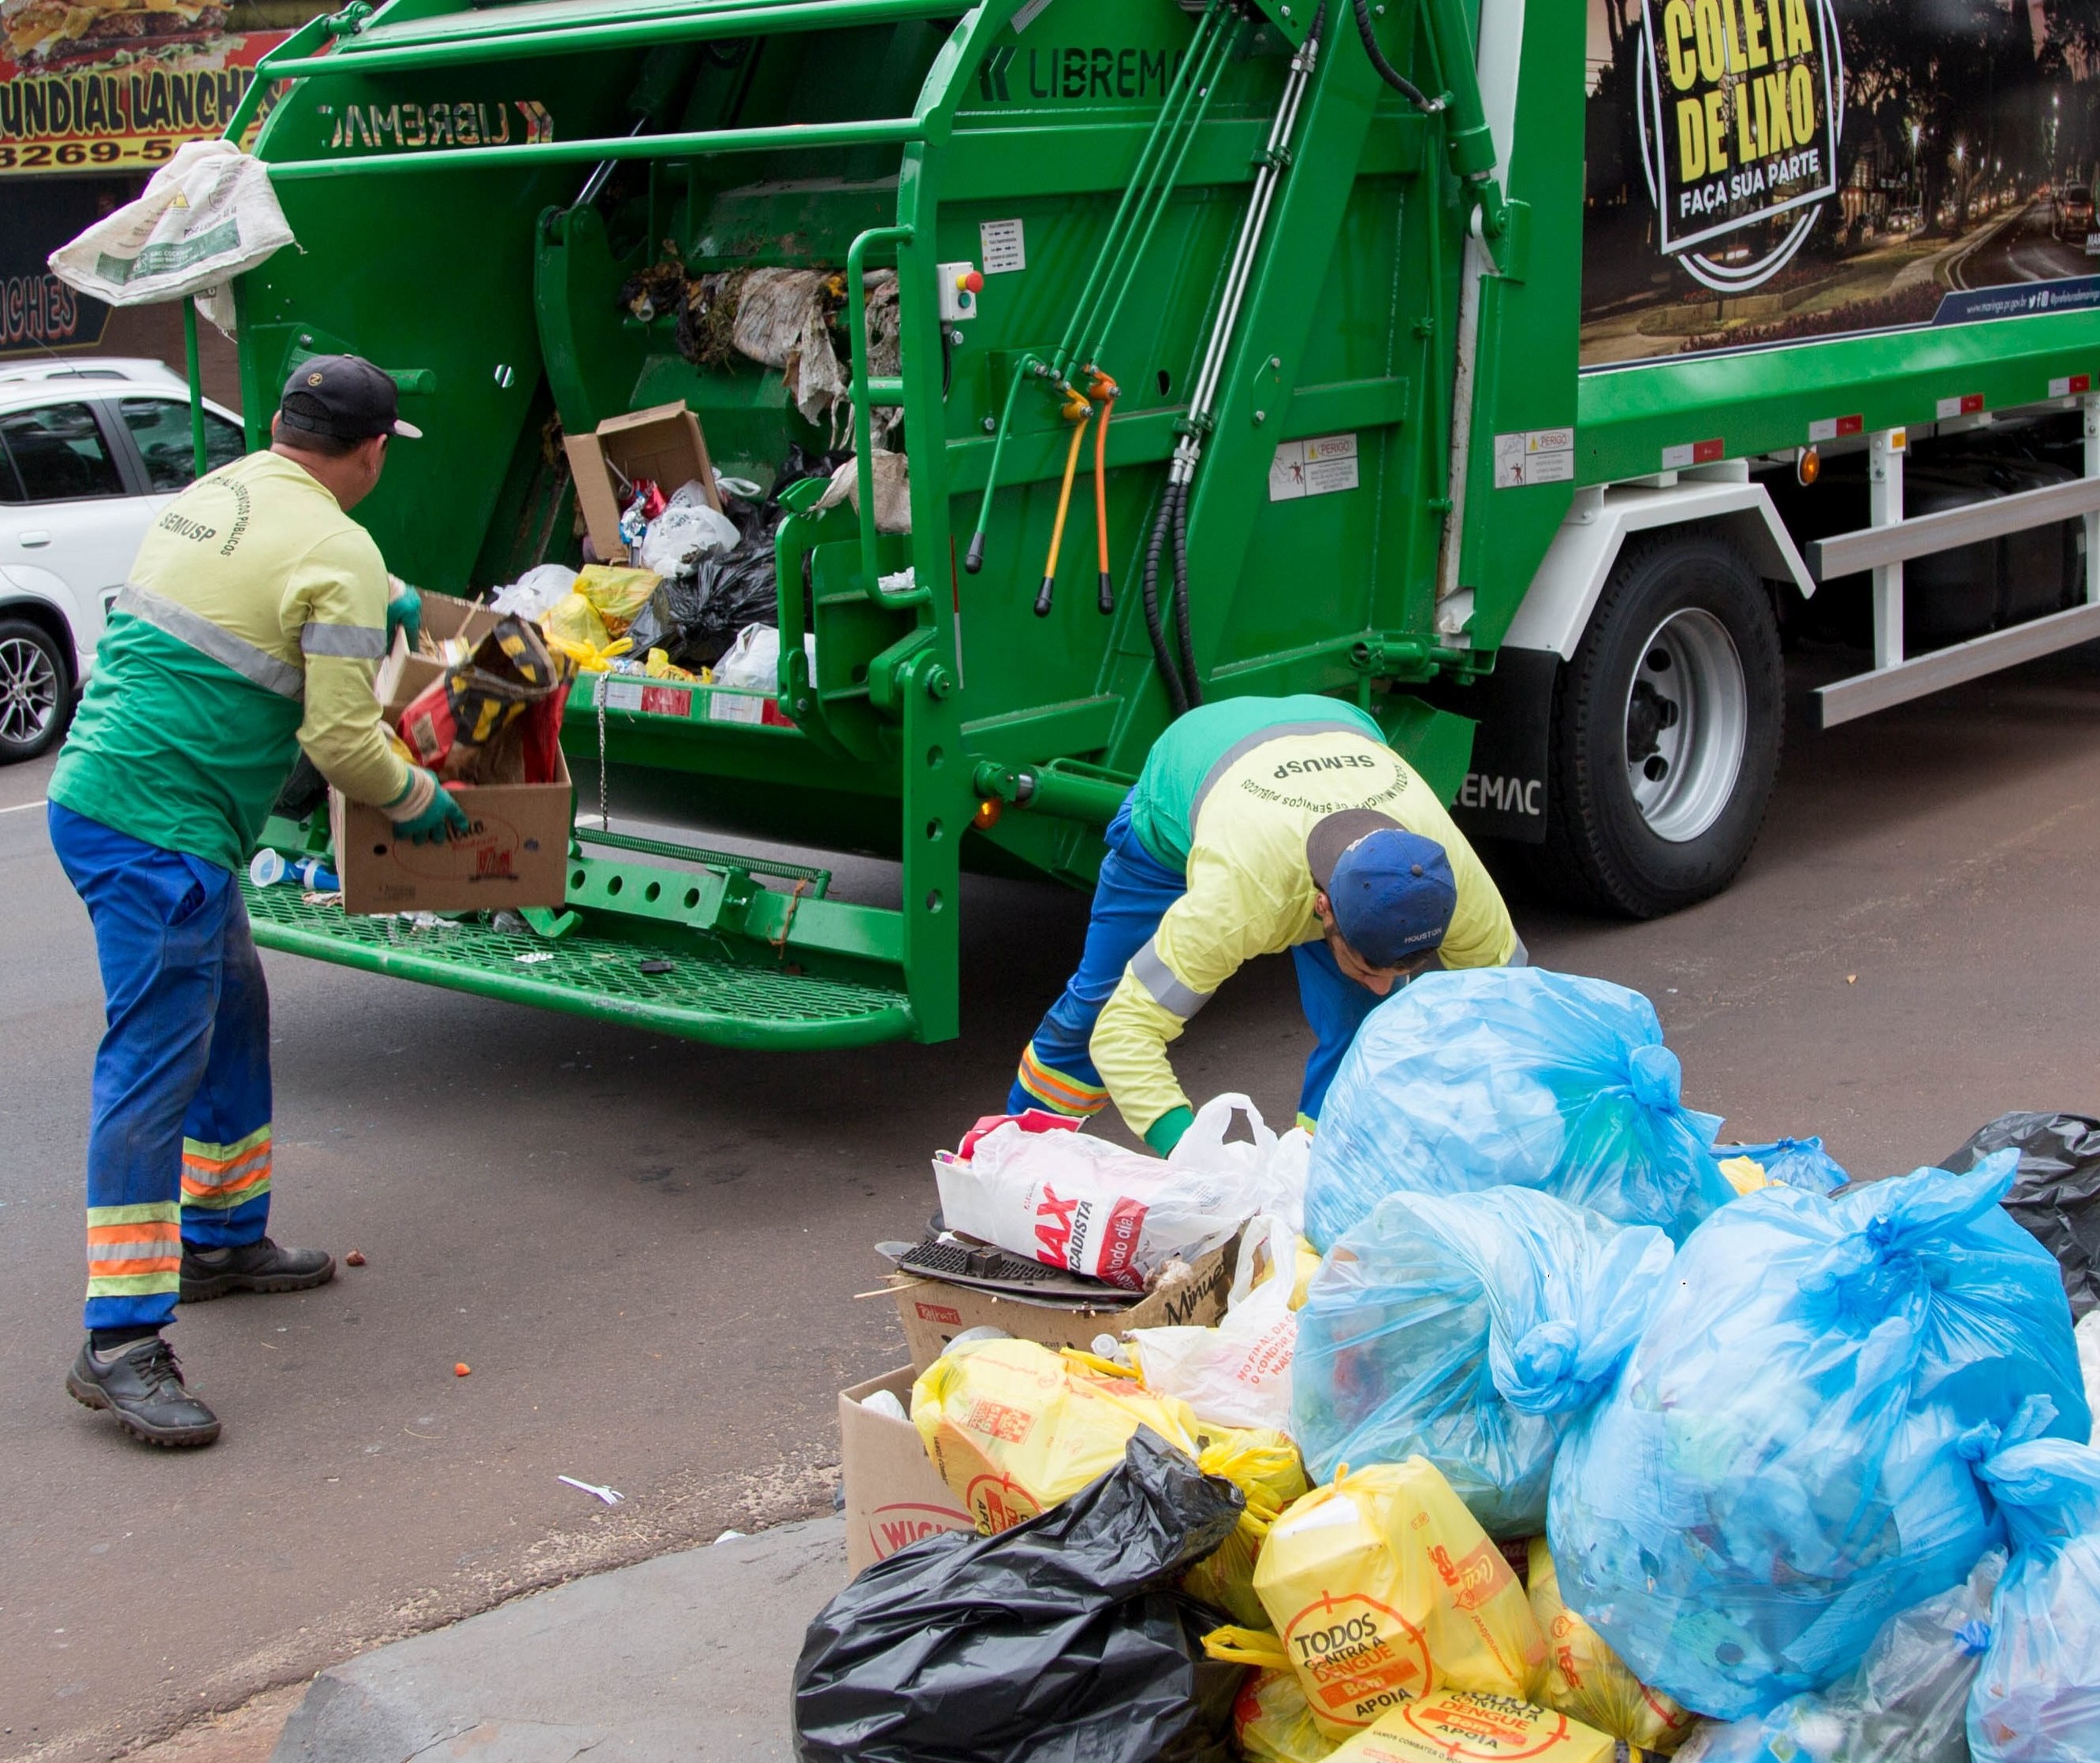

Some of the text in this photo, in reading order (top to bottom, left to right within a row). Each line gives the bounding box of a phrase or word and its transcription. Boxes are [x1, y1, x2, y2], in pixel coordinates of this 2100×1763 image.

[1664, 0, 1813, 91] COLETA
[1029, 47, 1192, 99] LIBREMA
[0, 73, 126, 139] UNDIAL
[1677, 64, 1814, 184] DE LIXO
[1681, 148, 1819, 218] FAÇA SUA PARTE
[0, 273, 76, 342] CHES
[1541, 434, 1566, 446] PERIGO
[159, 512, 217, 542] SEMUSP
[1274, 755, 1375, 779] SEMUSP
[1452, 773, 1542, 816] EMAC
[1404, 926, 1443, 944] HOUSTON
[1069, 1200, 1093, 1274] CADISTA
[1108, 1241, 1128, 1270] todo
[1294, 1612, 1377, 1658] TODOS
[1372, 1635, 1386, 1648] A
[1312, 1644, 1396, 1683] DENGUE
[1355, 1687, 1413, 1717] APOIA
[1439, 1701, 1531, 1731] DENGUE
[1435, 1724, 1498, 1749] APOIA
